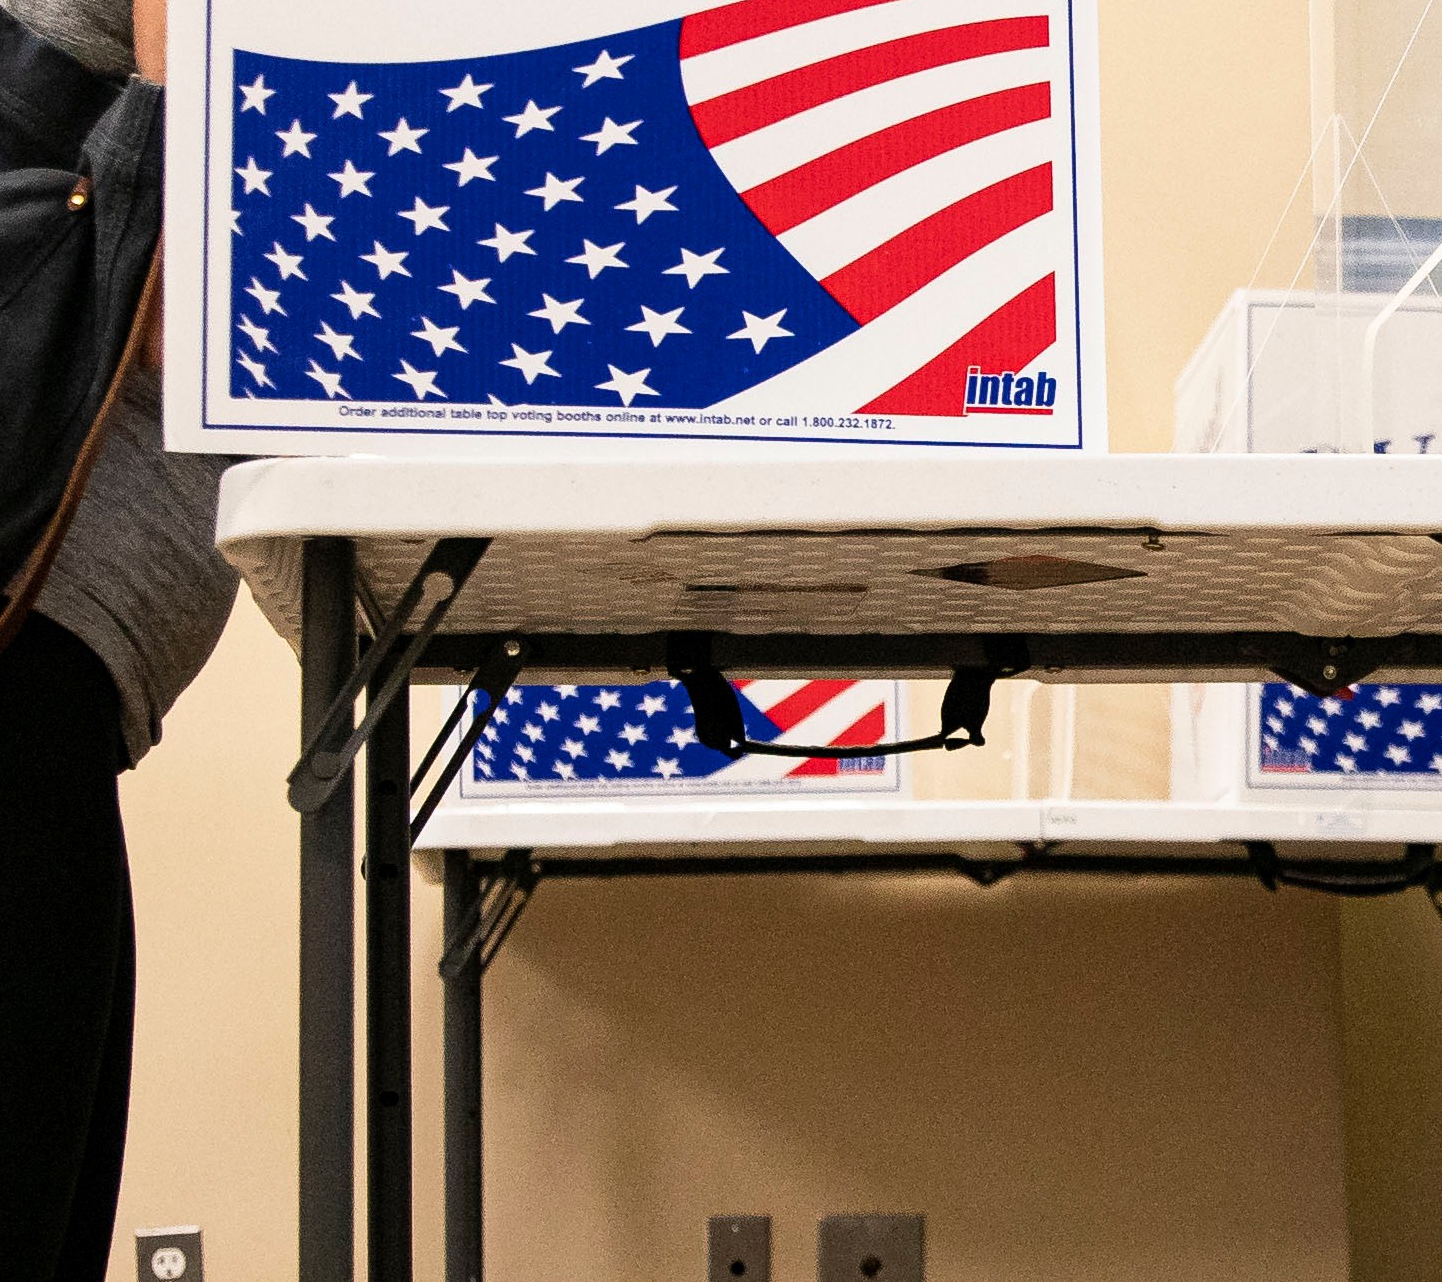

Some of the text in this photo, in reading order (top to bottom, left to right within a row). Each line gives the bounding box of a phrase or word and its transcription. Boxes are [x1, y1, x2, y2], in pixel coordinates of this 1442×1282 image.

[965, 366, 1058, 408] intab
[339, 405, 377, 417] Order
[381, 407, 446, 418] additional
[450, 409, 482, 420] table
[486, 410, 508, 422] top
[512, 411, 553, 423] voting
[557, 411, 602, 422] booths
[605, 413, 645, 423] online
[649, 414, 662, 423] at
[665, 415, 755, 426] www.intab.net
[759, 417, 773, 426] or
[776, 417, 798, 427] call
